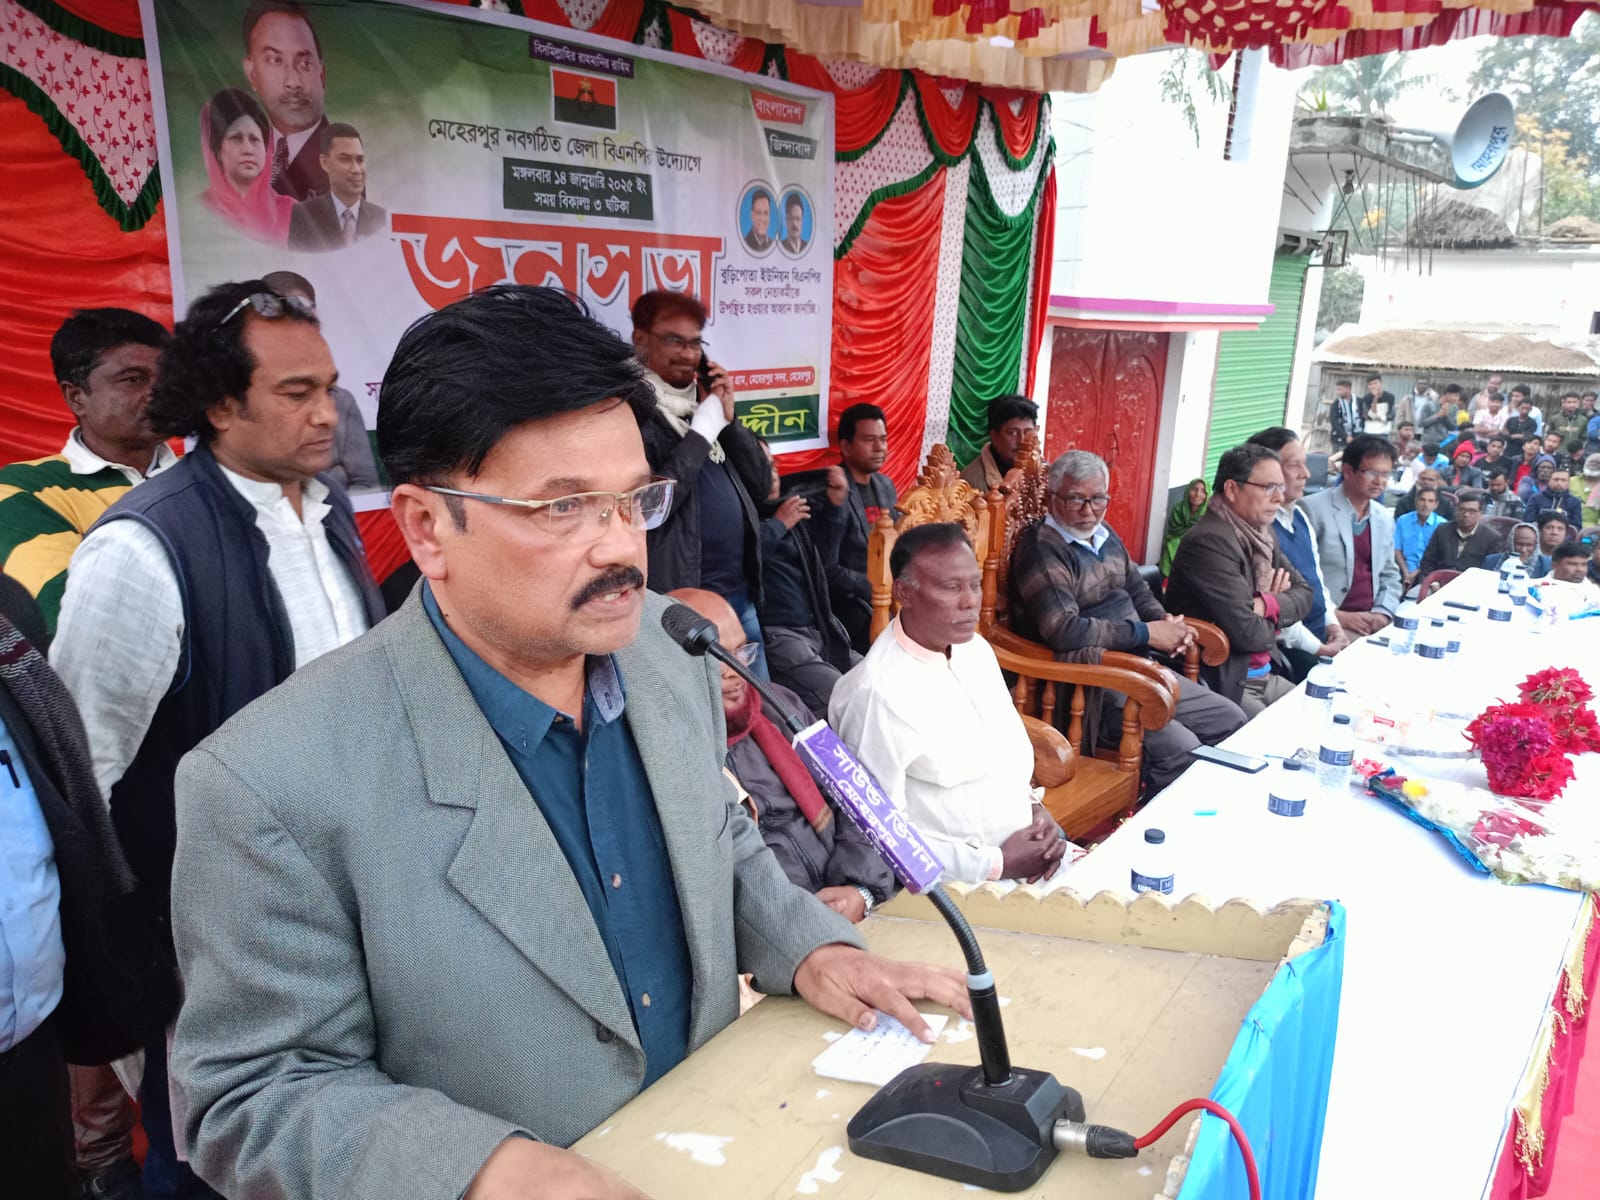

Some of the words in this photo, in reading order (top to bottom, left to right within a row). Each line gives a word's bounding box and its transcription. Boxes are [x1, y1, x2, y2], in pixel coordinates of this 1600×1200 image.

[755, 98, 803, 121] বাংলাদেশ
[428, 118, 501, 152] মেহেরপুর
[504, 125, 563, 152] নবগঠিত
[567, 137, 599, 160] জেলা
[602, 136, 655, 166] বিএনপির
[655, 144, 702, 173] উদ্যোগে
[769, 134, 812, 157] জিন্দাবাদ
[511, 166, 552, 185] মঙ্গলবার
[553, 171, 567, 186] ১৪
[568, 170, 606, 192] জানুয়ারি
[607, 177, 633, 193] ২০২৫
[635, 175, 648, 195] ইং
[533, 192, 556, 209] সময়
[557, 190, 591, 211] বিকালঃ
[593, 199, 603, 212] ৩
[604, 195, 631, 214] ঘটিকা
[391, 212, 725, 320] জনসভা
[759, 265, 791, 283] ইউনিয়ন
[791, 267, 822, 284] বিএনপির
[744, 286, 762, 297] সকল
[719, 299, 745, 317] উপস্থিত
[737, 403, 810, 437] দ্দীন
[884, 806, 939, 873] ভিশন
